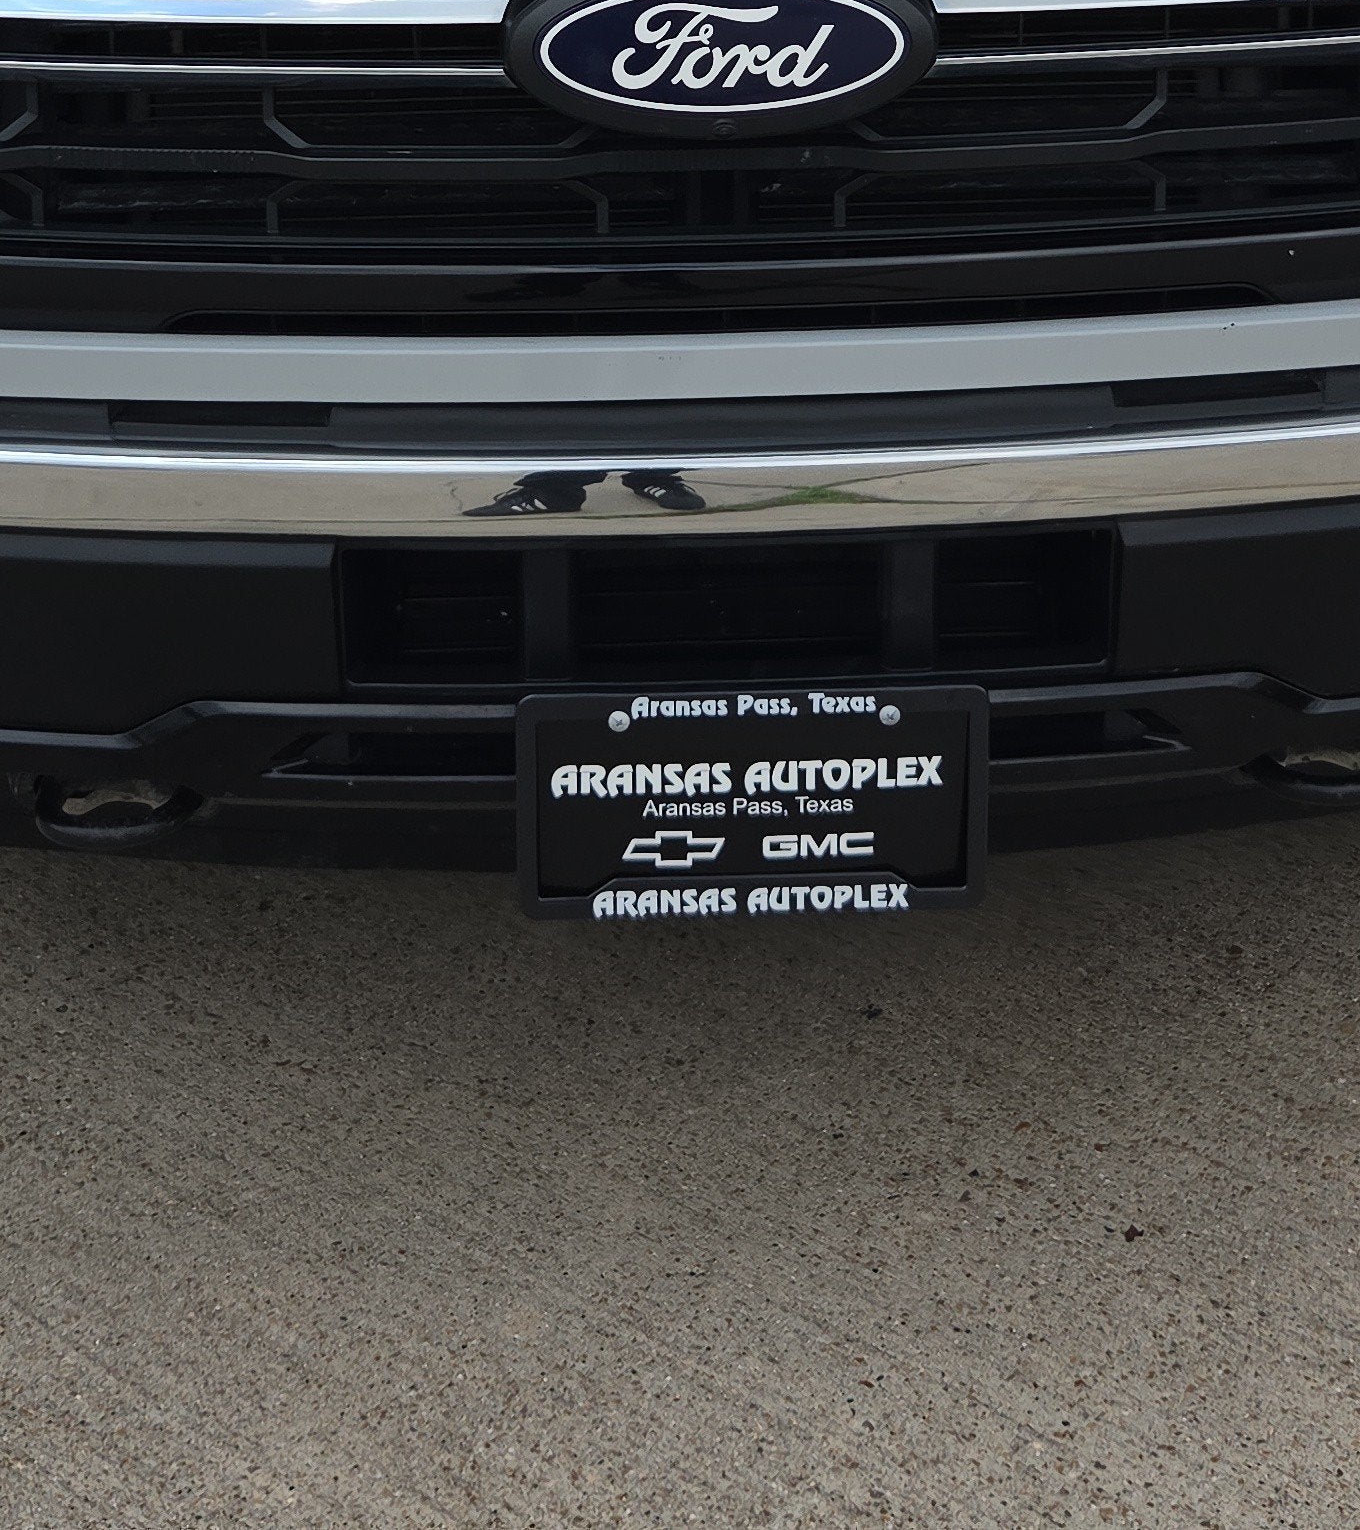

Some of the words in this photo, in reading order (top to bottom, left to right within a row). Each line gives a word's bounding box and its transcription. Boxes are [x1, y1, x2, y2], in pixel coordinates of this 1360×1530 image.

[612, 3, 834, 90] Ford
[631, 696, 728, 720] Aransas
[737, 694, 798, 716] Pass,
[808, 692, 876, 715] Texas
[551, 762, 733, 799] ARANSAS
[744, 755, 944, 796] AUTOPLEX
[642, 799, 726, 817] Aransas
[733, 797, 789, 816] Pass,
[794, 795, 854, 813] Texas
[762, 831, 875, 858] GMC
[592, 887, 738, 919] ARANSAS
[747, 883, 910, 915] AUTOPLEX
